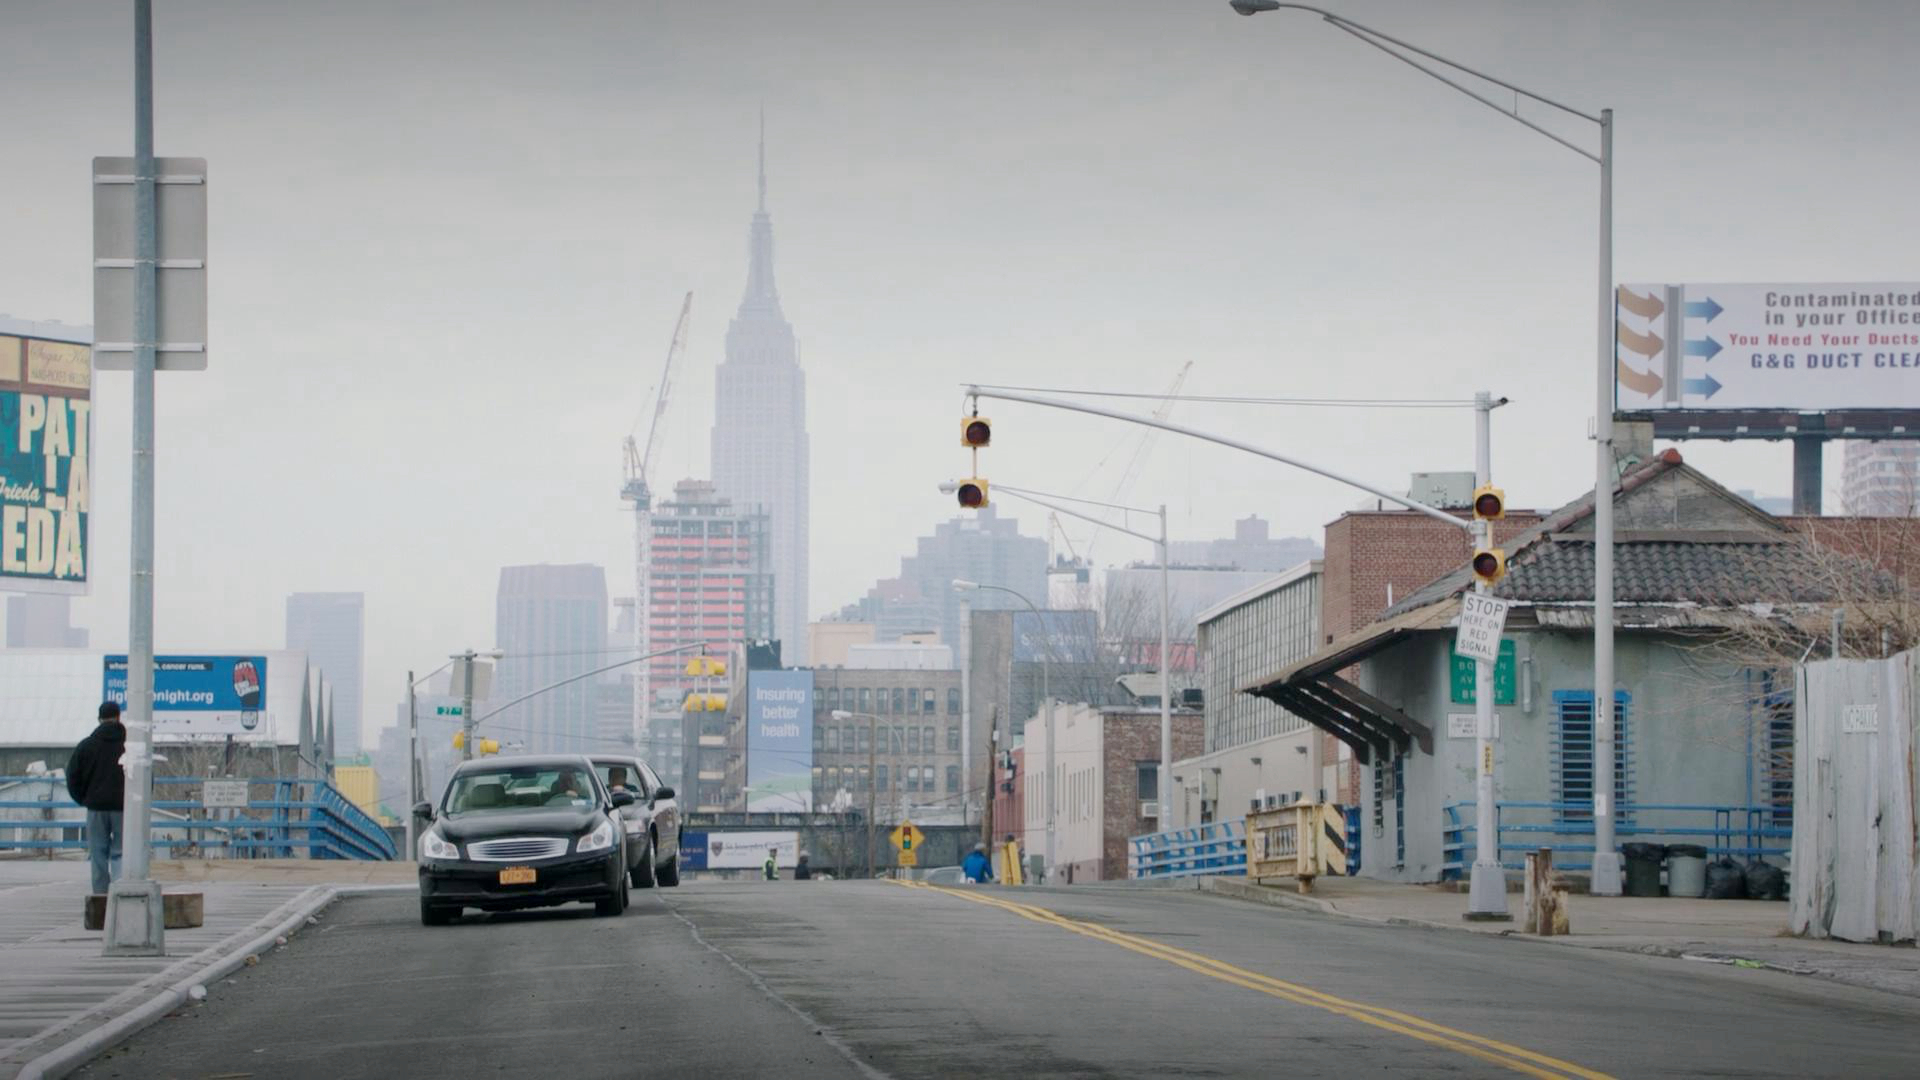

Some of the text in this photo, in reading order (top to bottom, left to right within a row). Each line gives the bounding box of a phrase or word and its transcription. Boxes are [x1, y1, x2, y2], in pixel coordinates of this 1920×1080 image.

[1765, 290, 1920, 308] Contaminated
[1765, 308, 1920, 328] in your Office
[1729, 332, 1919, 346] You Need Your Ducts
[1751, 352, 1795, 369] G&G
[1806, 352, 1863, 369] DUCT
[19, 393, 90, 457] PAT
[45, 454, 89, 512] LA
[3, 504, 85, 579] EDA
[1466, 597, 1504, 617] STOP
[1463, 614, 1499, 630] HERE ON
[1469, 628, 1488, 641] RED
[1460, 639, 1493, 656] SIGNAL
[756, 687, 806, 704] Insuring
[762, 705, 799, 719] better
[761, 722, 800, 737] health
